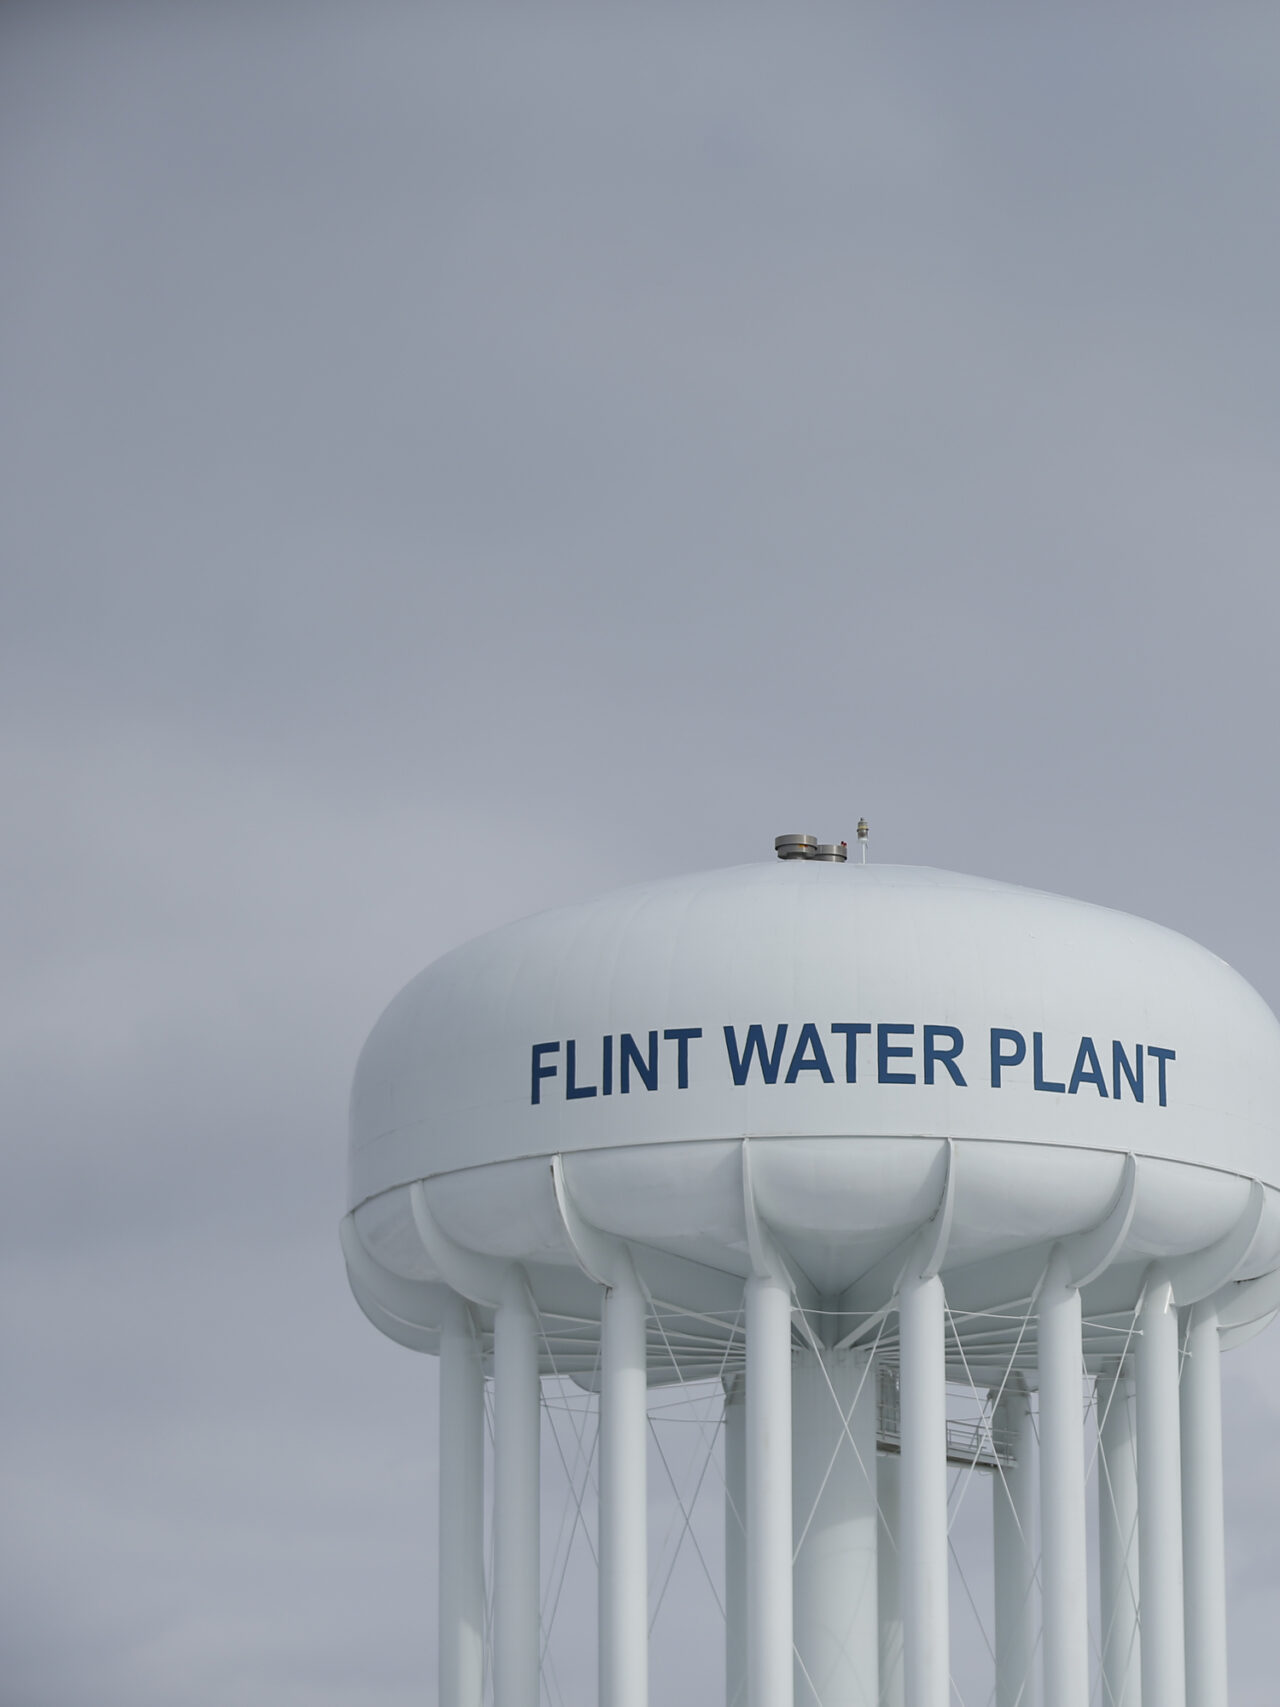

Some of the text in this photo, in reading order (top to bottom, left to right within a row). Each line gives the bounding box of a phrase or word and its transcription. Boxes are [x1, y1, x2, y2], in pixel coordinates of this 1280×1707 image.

[531, 1023, 1177, 1107] FLINT WATER PLANT
